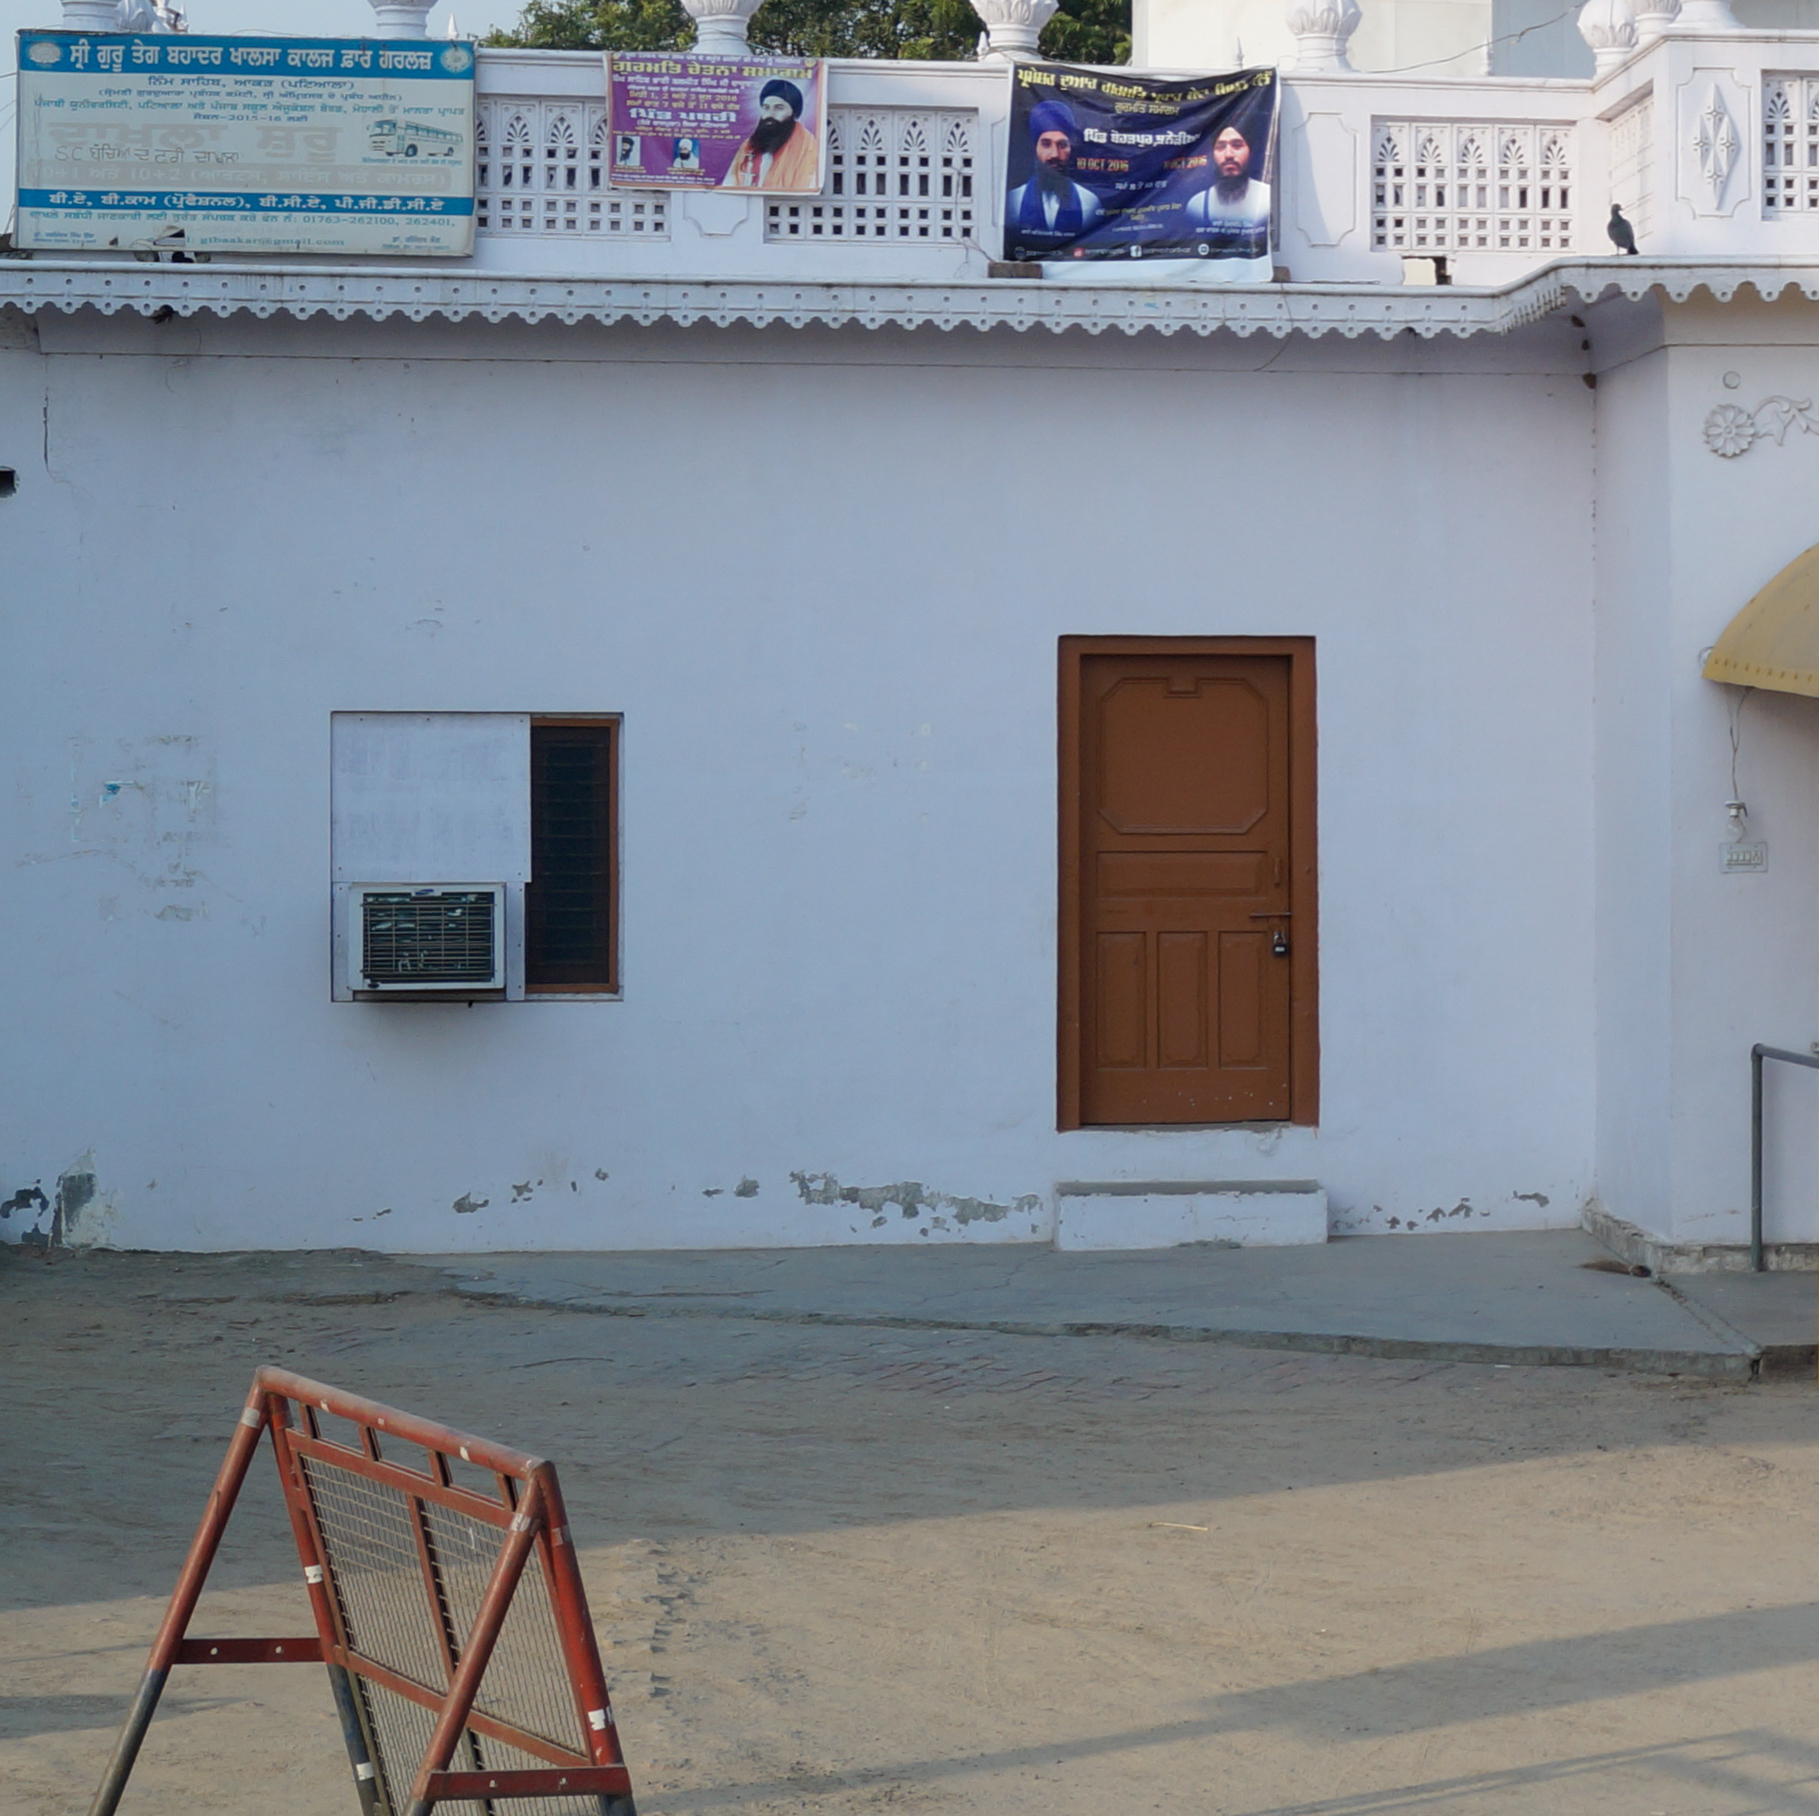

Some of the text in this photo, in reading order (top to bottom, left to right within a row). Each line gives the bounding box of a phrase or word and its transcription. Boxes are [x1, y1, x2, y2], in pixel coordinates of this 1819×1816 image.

[70, 37, 91, 70] ਸ੍ਰੀ
[97, 45, 125, 72] ਗੁਰੂ
[131, 39, 160, 64] ਤੇਗ
[166, 46, 224, 65] ਬਹਾਦਰ
[229, 48, 282, 66] ਖਾਲਸਾ
[287, 49, 335, 68] ਕਾਲਜ
[613, 60, 813, 79] ਗੁਰਮਤਿ ਚੇਤਨਾ ਸਮਾਗਮ
